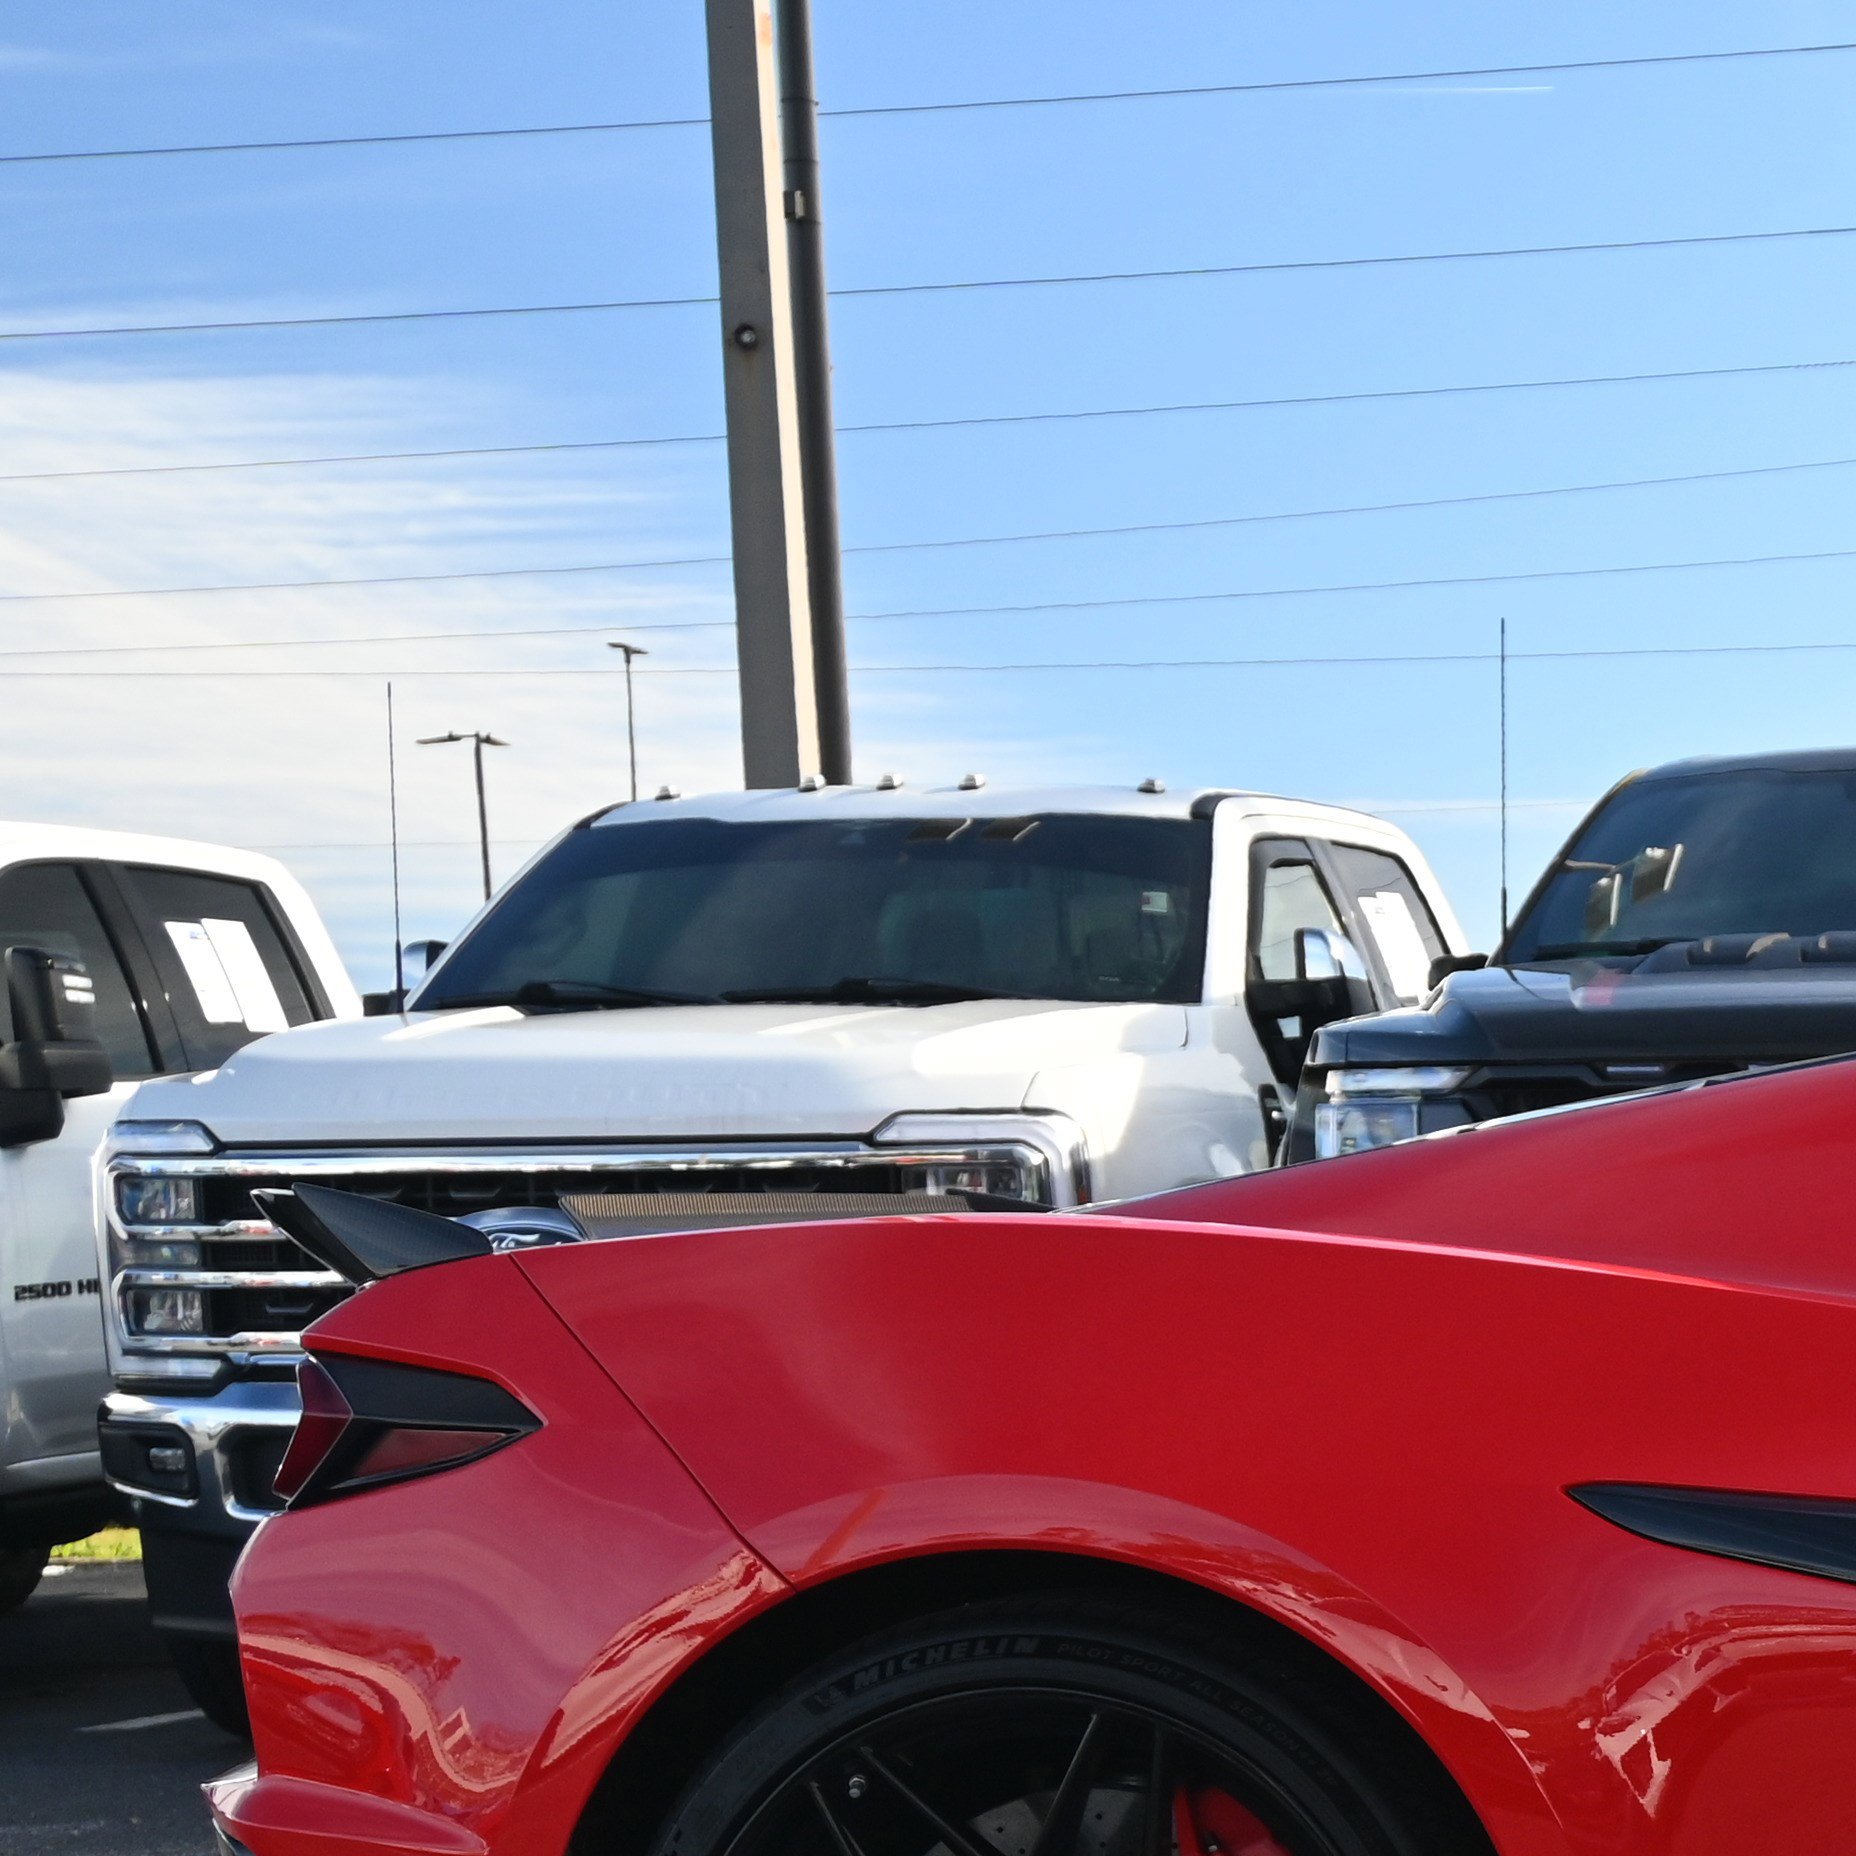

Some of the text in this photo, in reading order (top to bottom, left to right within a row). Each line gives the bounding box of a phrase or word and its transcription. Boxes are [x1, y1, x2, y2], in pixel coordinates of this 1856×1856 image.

[14, 1280, 72, 1301] 2500
[852, 1637, 1039, 1690] MICHELIN
[1055, 1641, 1115, 1662] PILOT
[1119, 1651, 1187, 1685] SPORT
[1187, 1675, 1227, 1703] ALL
[1228, 1696, 1302, 1754] SEASON
